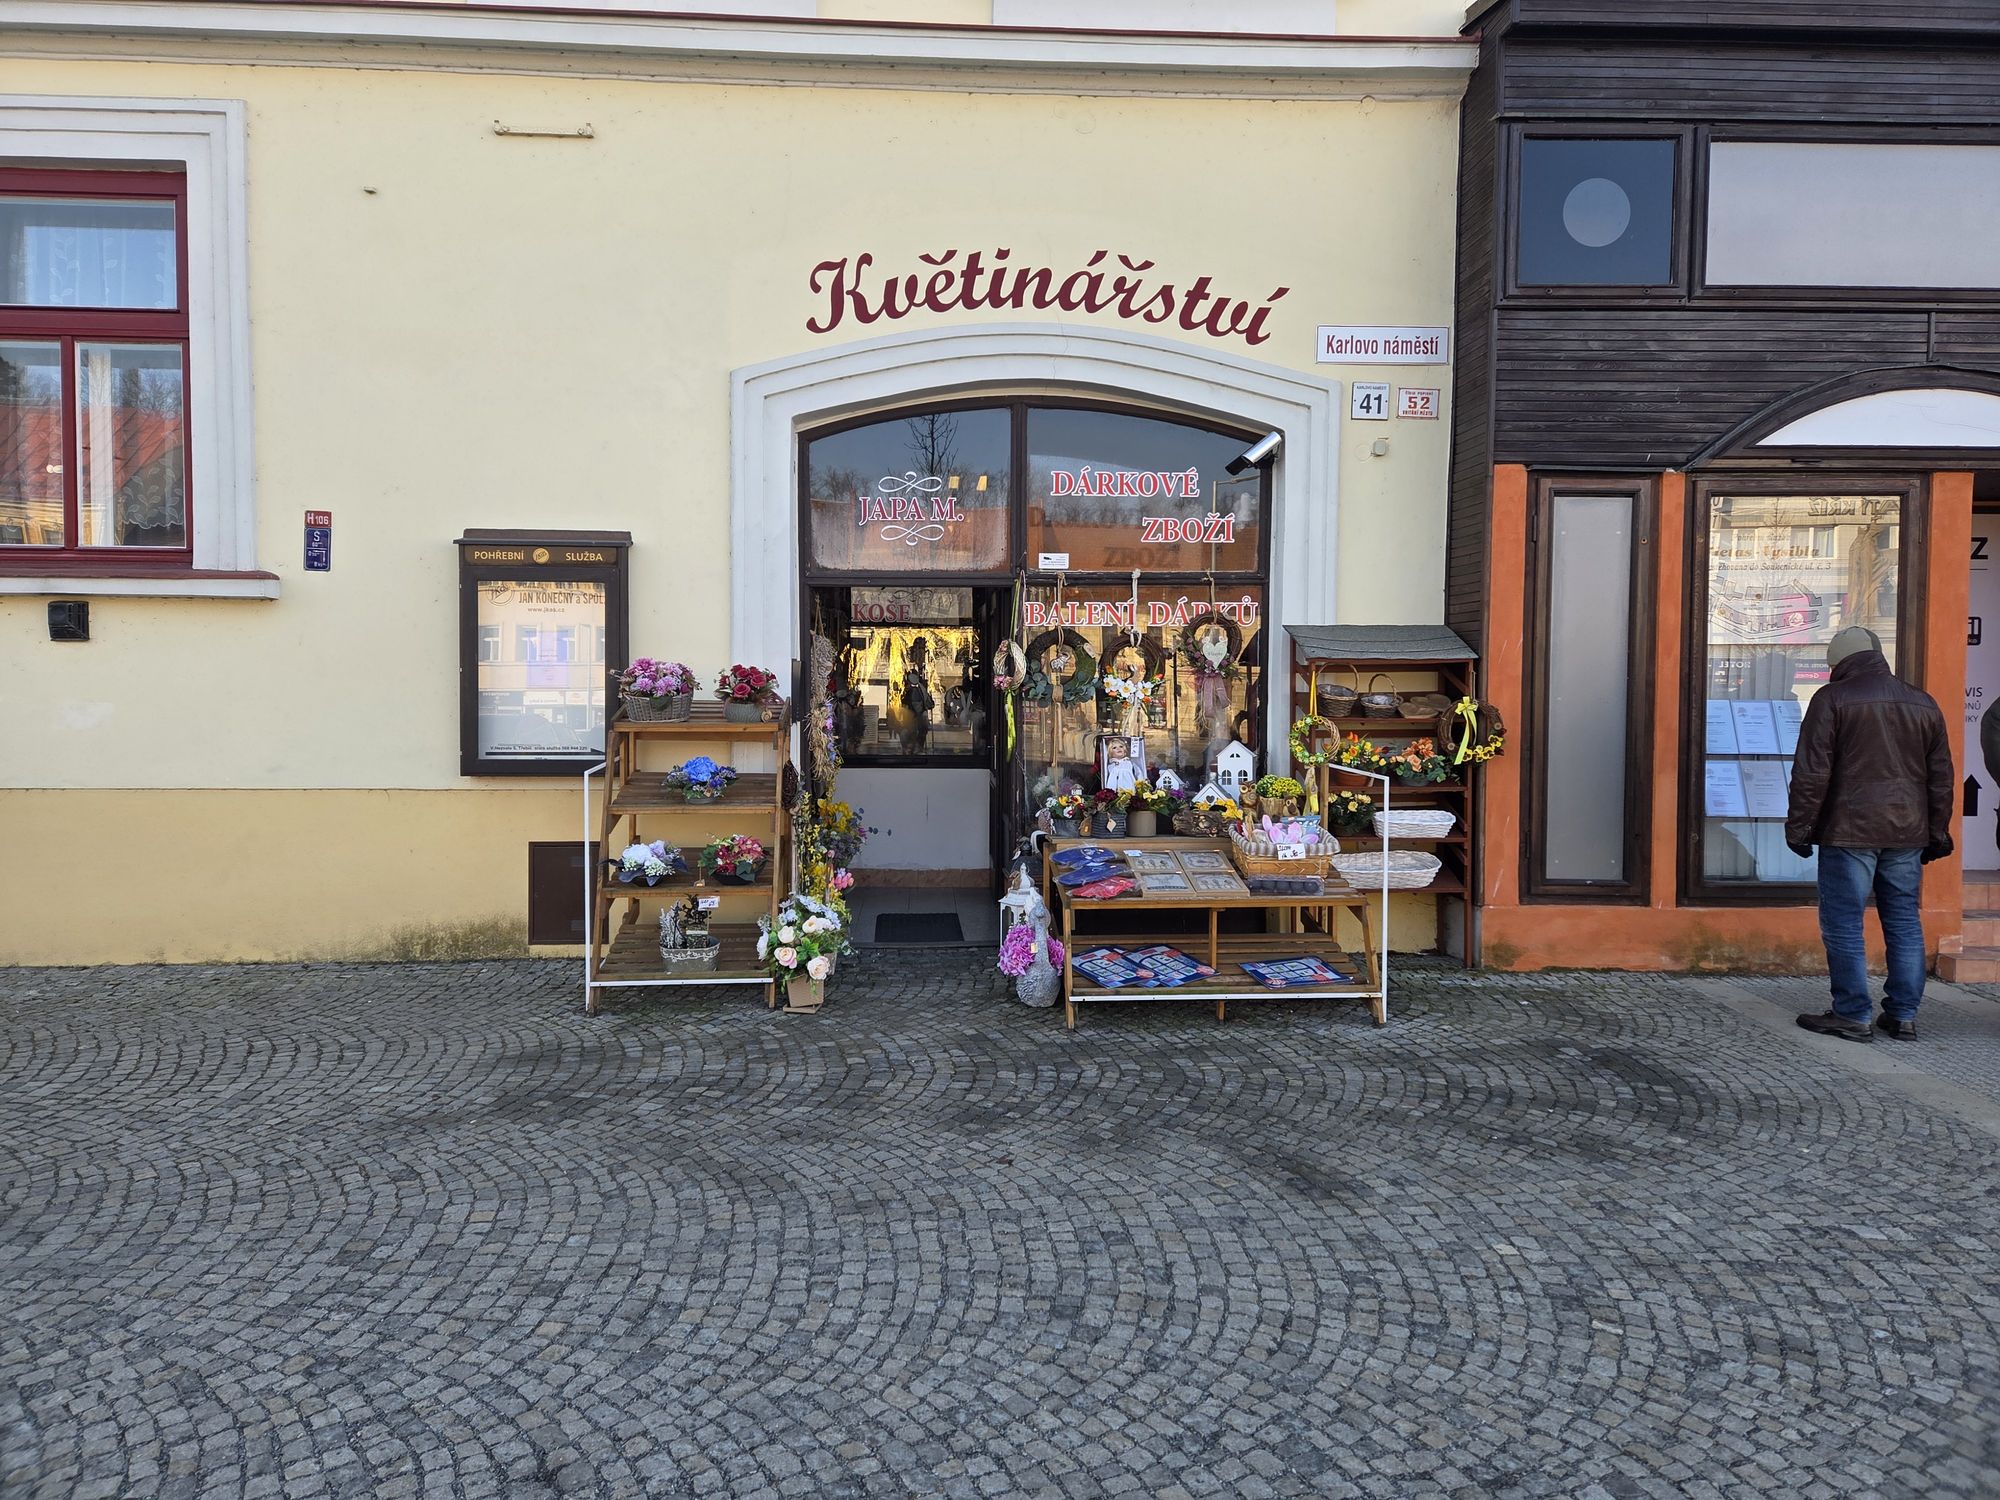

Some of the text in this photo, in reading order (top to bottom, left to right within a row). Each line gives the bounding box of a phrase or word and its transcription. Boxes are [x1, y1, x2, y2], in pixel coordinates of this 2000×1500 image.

[806, 248, 1291, 345] Květinářství
[1326, 335, 1440, 355] Karlovo náměstí
[1359, 393, 1383, 415] 41
[1408, 396, 1430, 410] 52
[1050, 466, 1200, 498] DÁRKOVÉ
[858, 496, 965, 526] JAPA M.
[1141, 511, 1236, 544] ZBOŽÍ
[474, 550, 603, 562] POHŘEBNÍ SLUŽBA
[518, 592, 534, 604] JAN
[536, 590, 574, 604] KONEČNÝ
[851, 599, 912, 623] KOŠE
[1025, 597, 1136, 627] BALENÍ
